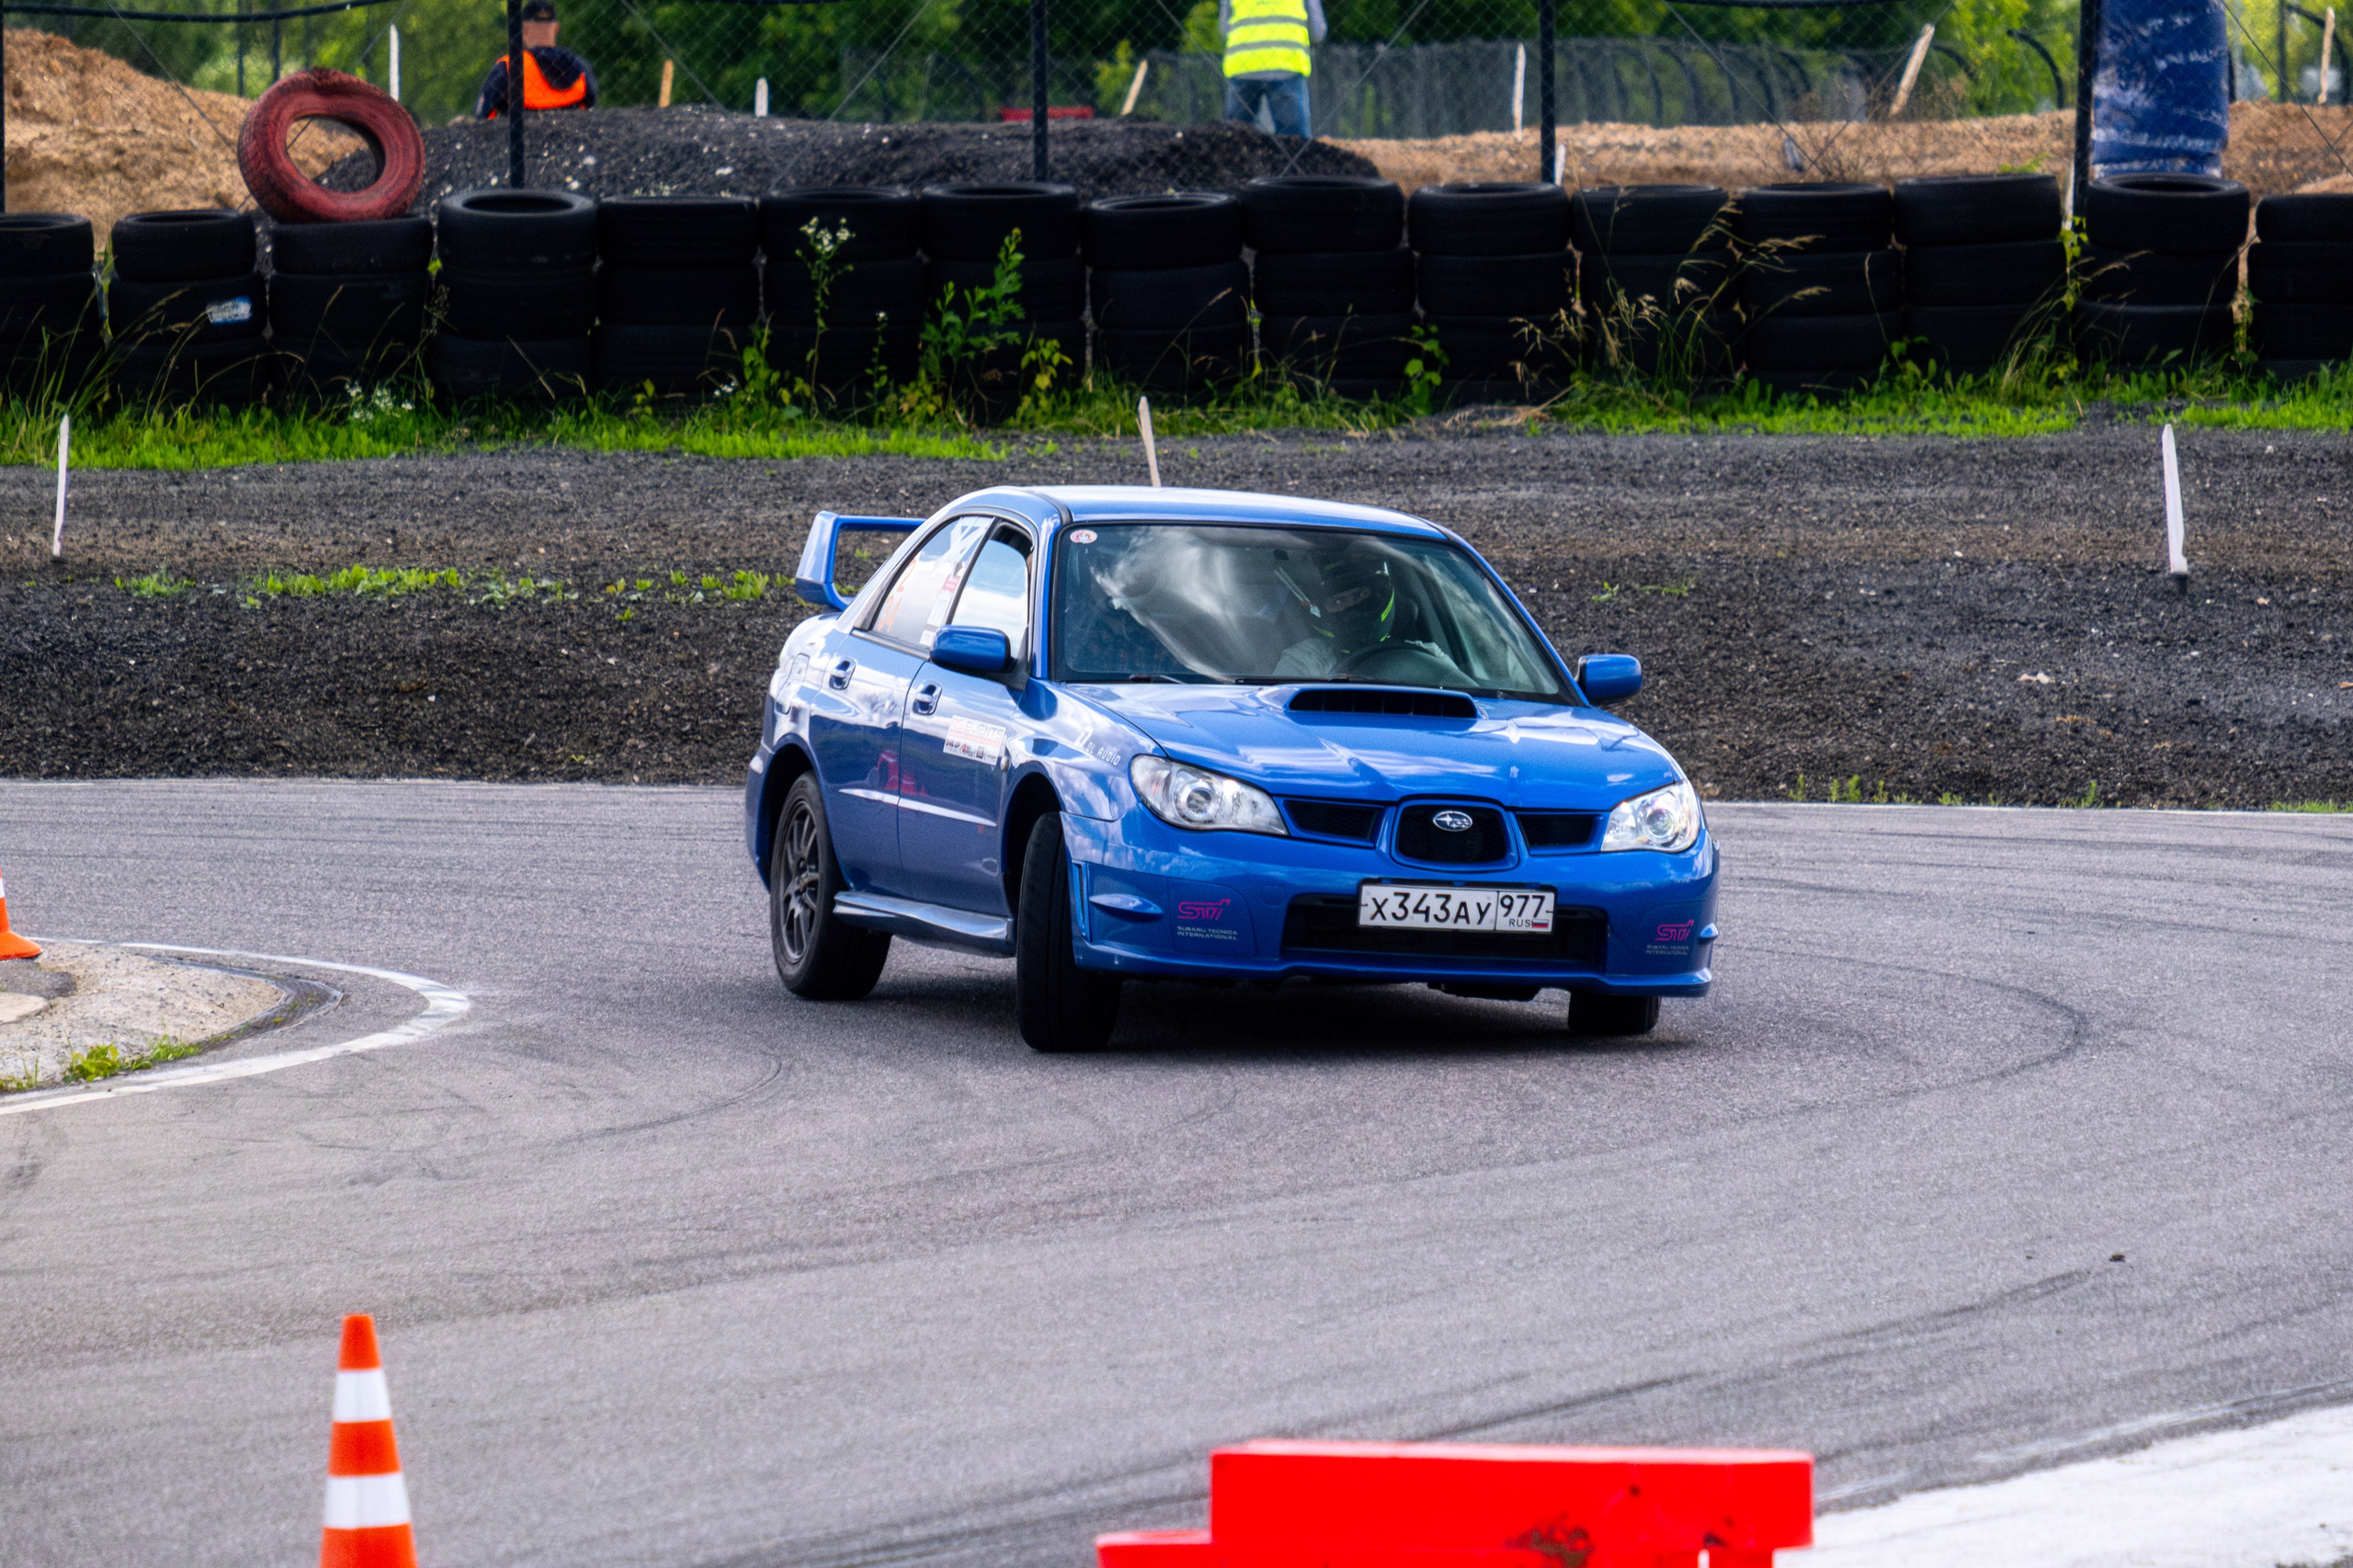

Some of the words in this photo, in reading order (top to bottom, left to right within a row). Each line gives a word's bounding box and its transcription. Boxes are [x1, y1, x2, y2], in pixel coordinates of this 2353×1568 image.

[965, 722, 1005, 740] EVENTS
[1097, 746, 1121, 766] AUDIO
[1500, 894, 1546, 918] 977
[1508, 919, 1531, 928] RUS
[1177, 931, 1237, 940] INTERNATIONAL
